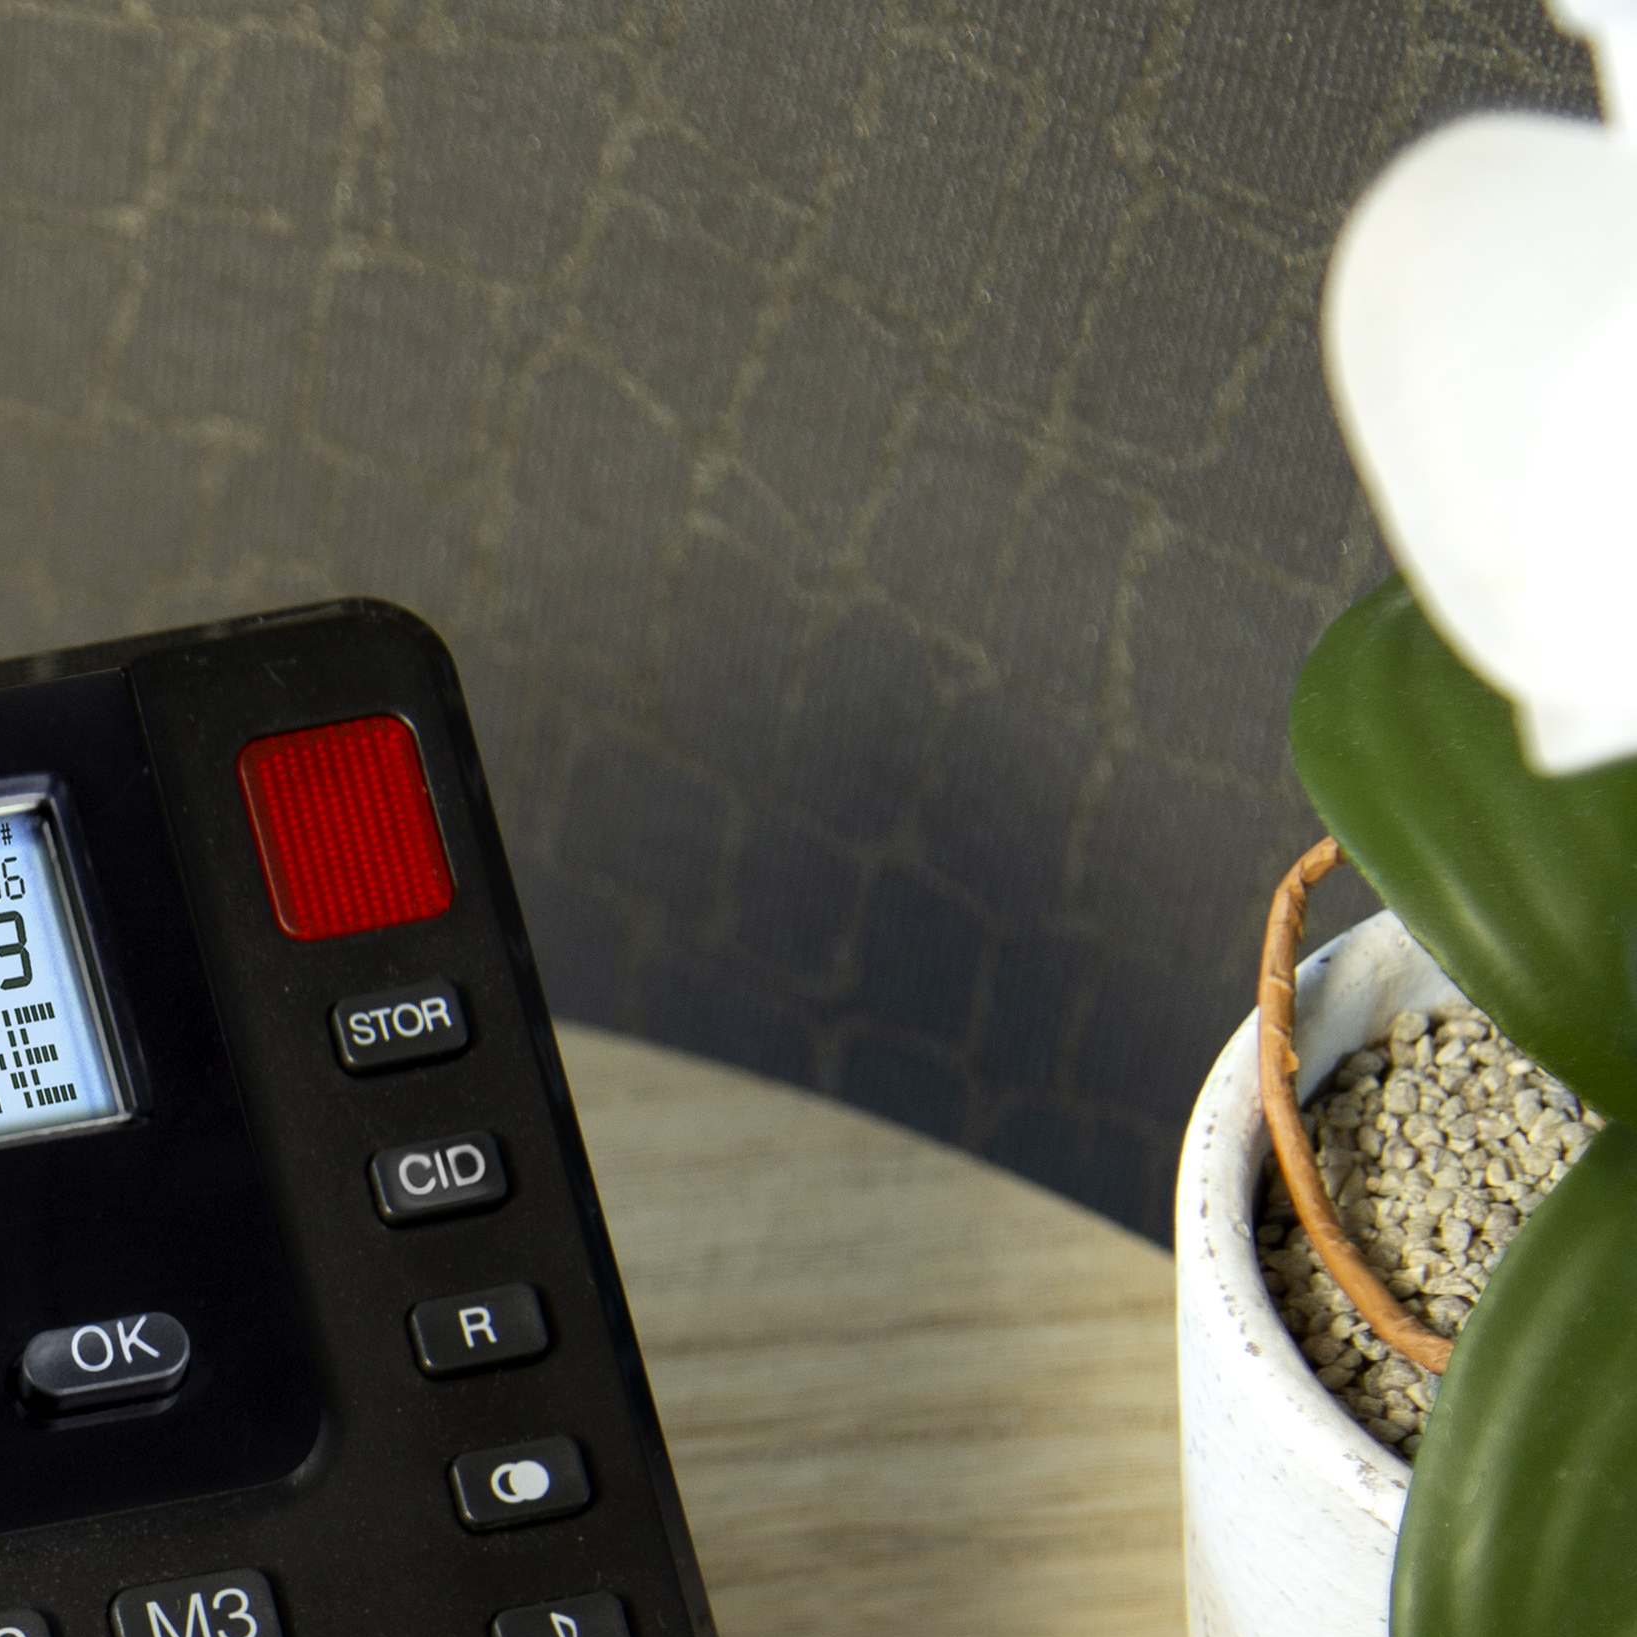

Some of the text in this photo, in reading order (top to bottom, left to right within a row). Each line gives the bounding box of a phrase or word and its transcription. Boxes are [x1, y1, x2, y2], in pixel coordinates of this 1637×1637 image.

[349, 997, 452, 1046] STOR
[398, 1143, 486, 1196] CID
[70, 1315, 160, 1372] OK
[459, 1306, 497, 1348] R
